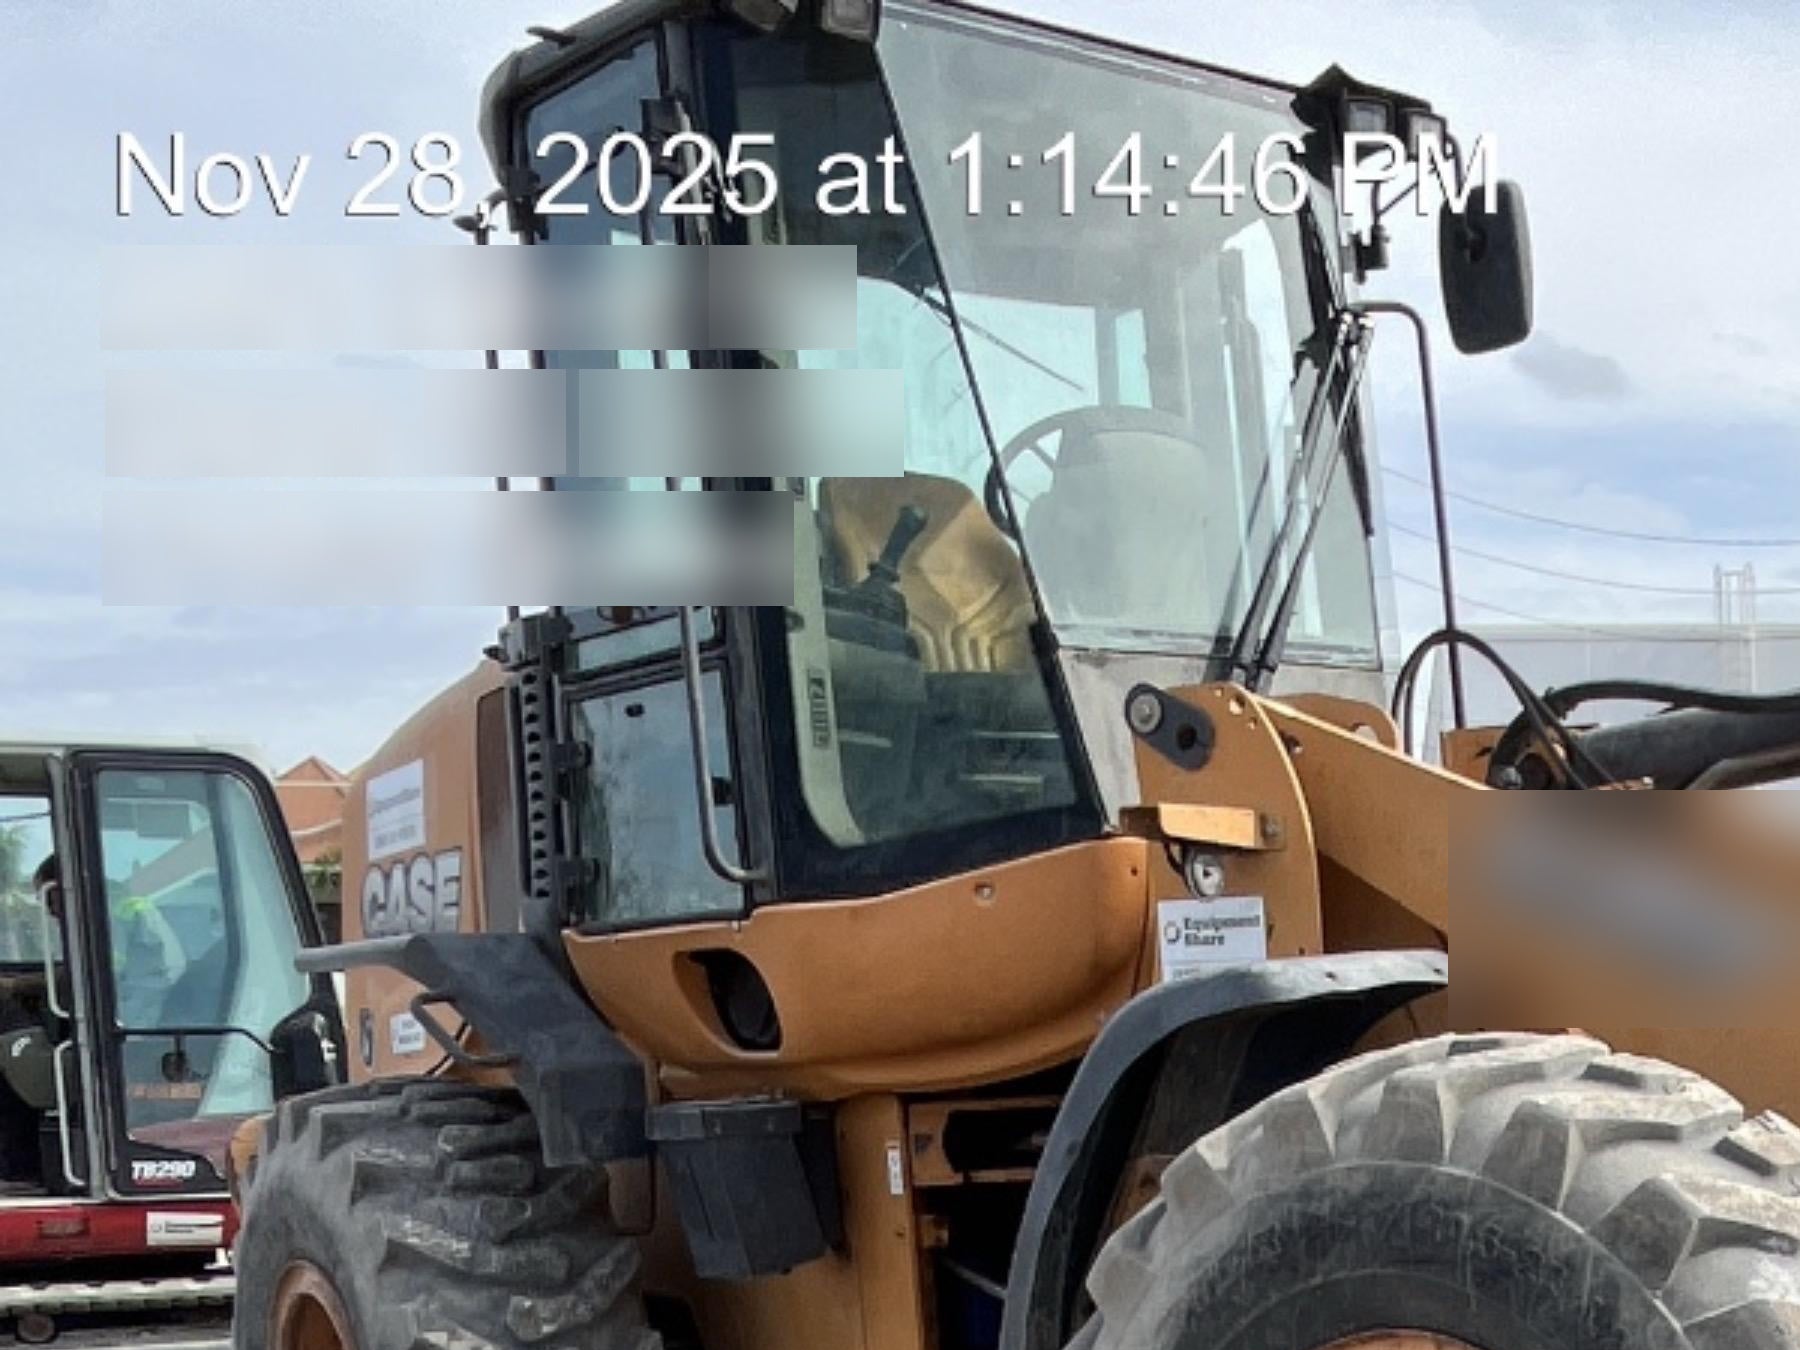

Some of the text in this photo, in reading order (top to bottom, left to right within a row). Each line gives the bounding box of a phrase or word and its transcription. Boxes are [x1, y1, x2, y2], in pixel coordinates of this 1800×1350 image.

[362, 847, 462, 937] CASE
[1184, 914, 1260, 932] Equipment
[1184, 933, 1225, 945] Share
